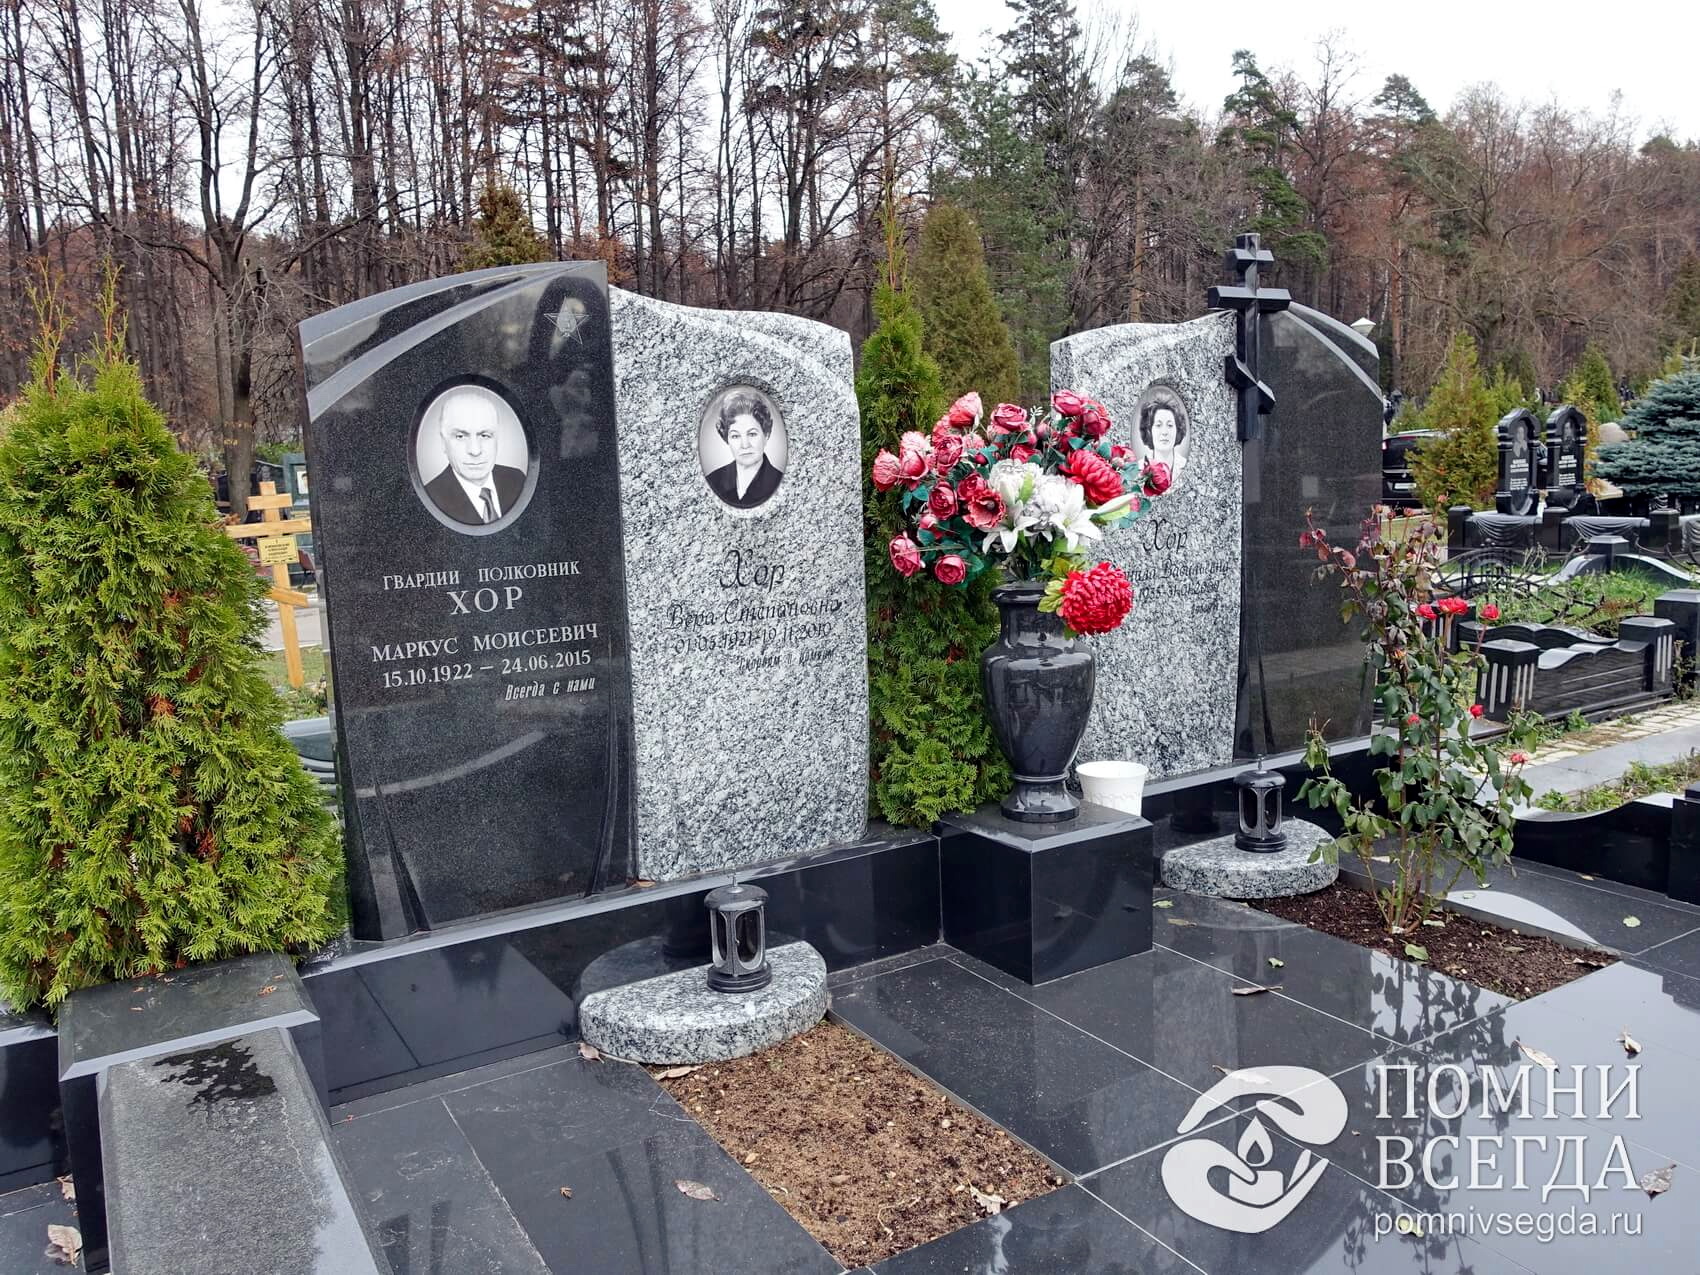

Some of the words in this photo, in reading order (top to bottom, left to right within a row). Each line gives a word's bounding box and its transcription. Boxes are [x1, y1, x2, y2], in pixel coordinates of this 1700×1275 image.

[383, 570, 460, 590] ГВАРДИИ
[478, 560, 581, 583] ПОЛКОВНИК
[719, 549, 785, 593] Хор
[447, 586, 523, 615] ХОР
[666, 603, 716, 631] Вера
[371, 637, 460, 662] МАРКУС
[473, 623, 599, 652] МОИСЕЕВИЧ
[383, 663, 473, 688] 15.10.1922
[501, 650, 592, 674] 24.06.2015
[505, 680, 545, 701] Всегда
[552, 680, 560, 694] с
[567, 676, 596, 693] нами
